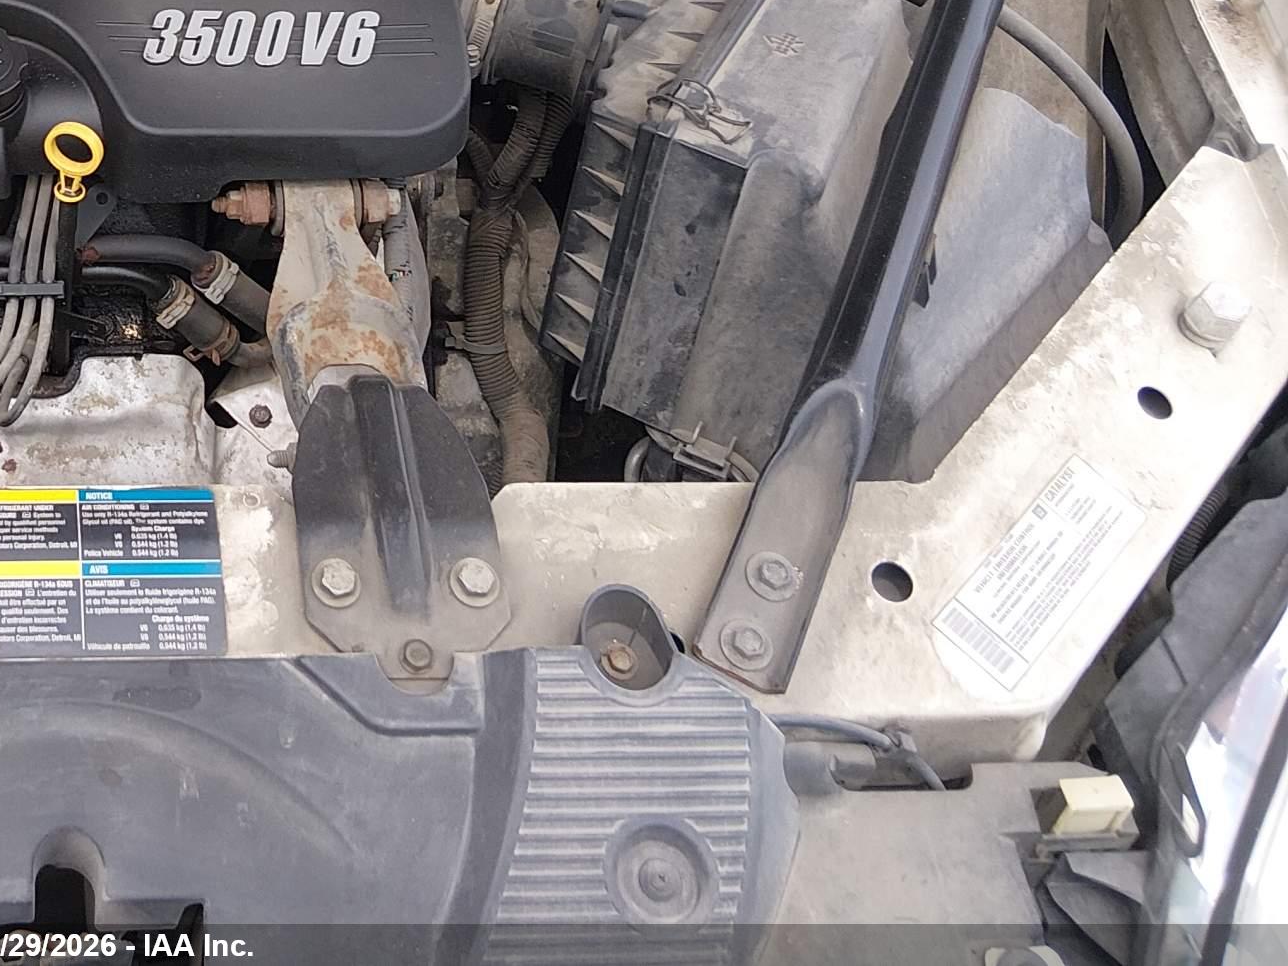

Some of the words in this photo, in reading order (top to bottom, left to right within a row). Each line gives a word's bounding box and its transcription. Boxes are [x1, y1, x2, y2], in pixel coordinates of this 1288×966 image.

[143, 9, 295, 66] 3500
[301, 11, 381, 66] V6
[89, 565, 108, 574] AVIS
